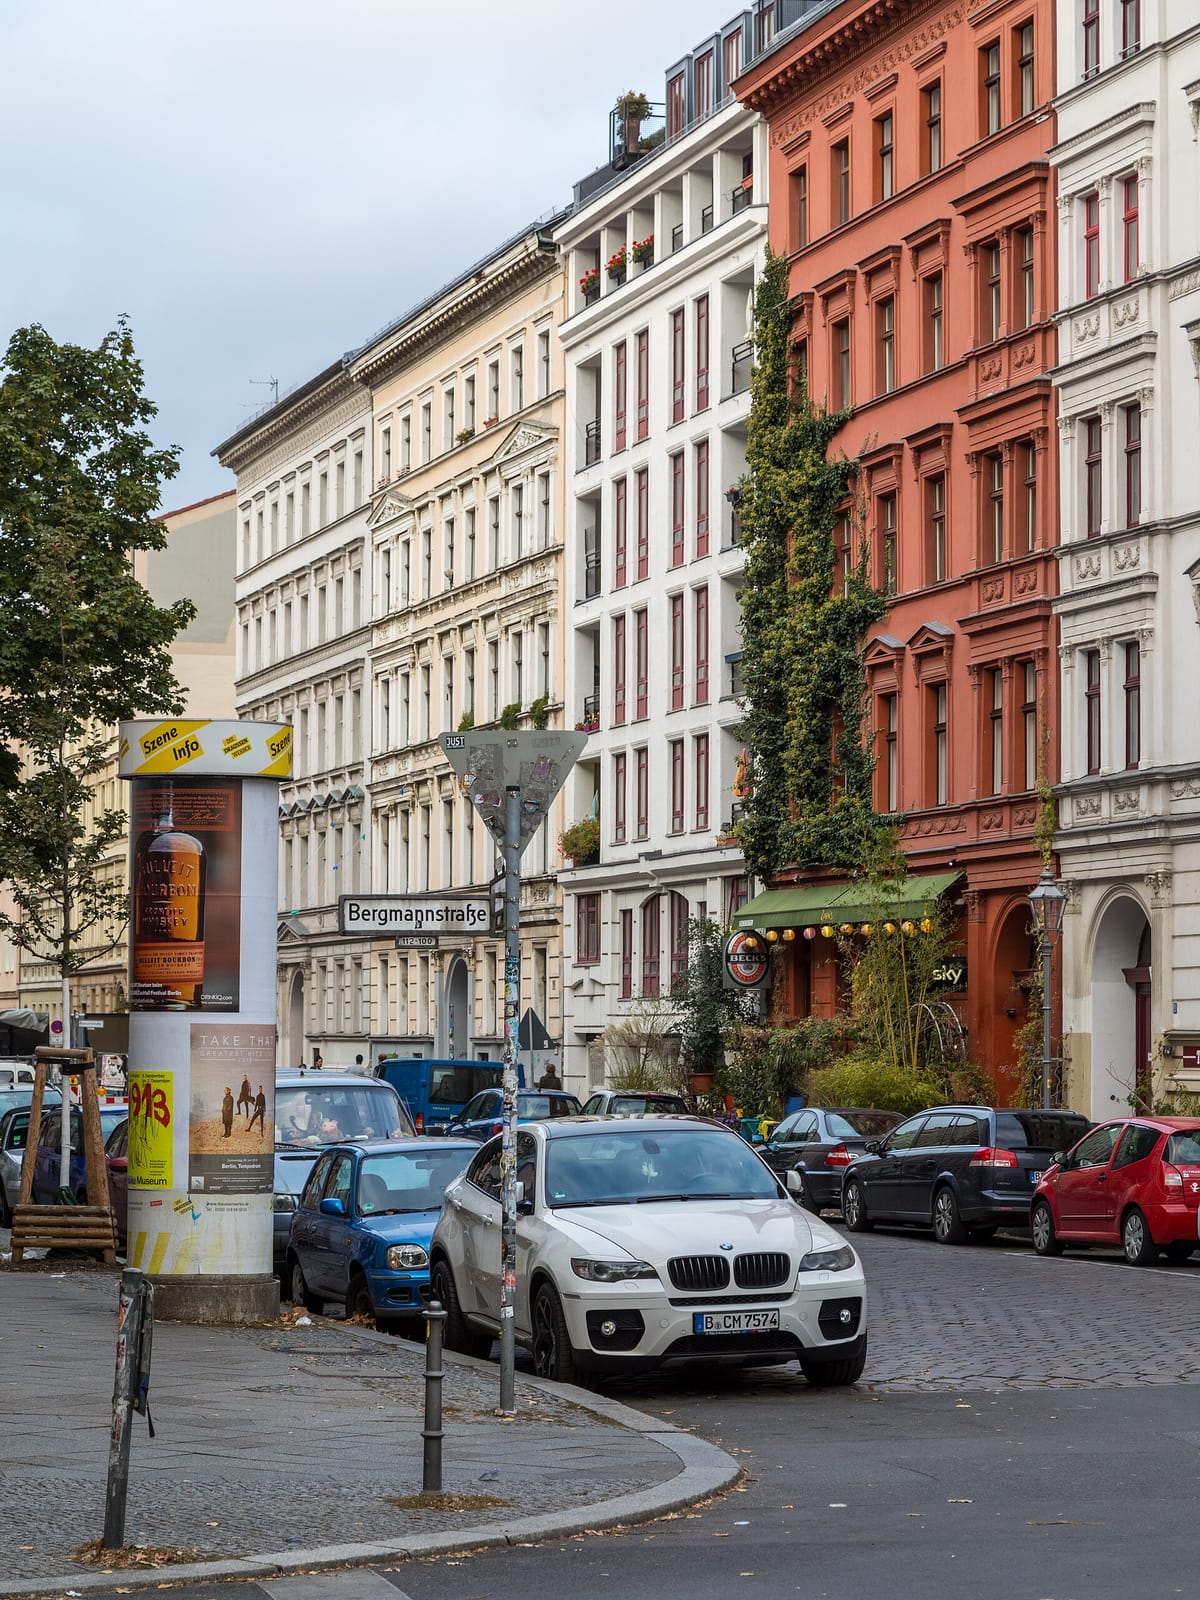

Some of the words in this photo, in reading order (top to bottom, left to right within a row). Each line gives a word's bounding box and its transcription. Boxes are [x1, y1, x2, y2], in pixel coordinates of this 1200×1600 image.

[143, 727, 178, 755] Szene
[172, 739, 199, 761] Info
[446, 737, 464, 746] JUST
[348, 903, 486, 926] Bergmannstraße
[932, 965, 962, 984] sky
[199, 1035, 240, 1047] TAKE
[136, 1176, 168, 1186] Museum
[705, 1316, 714, 1329] B
[723, 1315, 741, 1328] CM
[744, 1312, 778, 1327] 7574
